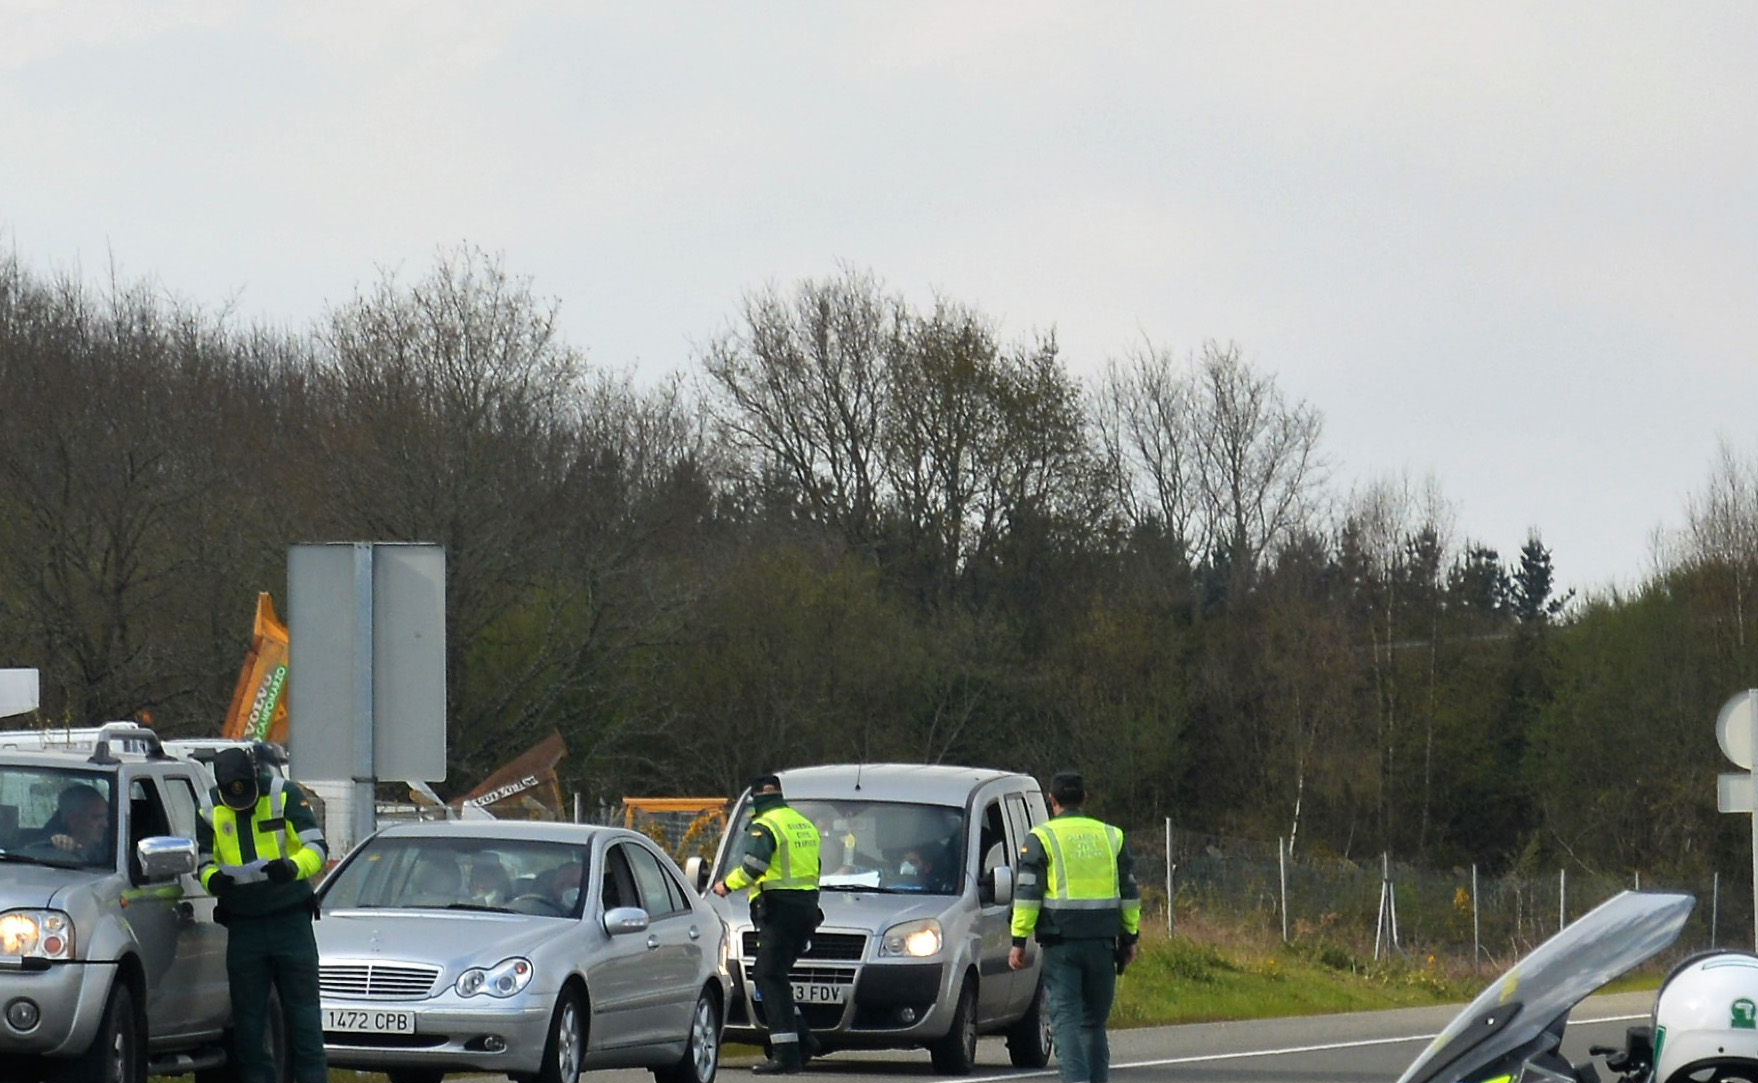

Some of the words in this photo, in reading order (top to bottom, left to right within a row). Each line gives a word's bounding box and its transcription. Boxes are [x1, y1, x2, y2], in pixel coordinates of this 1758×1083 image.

[244, 673, 272, 737] VOLVO
[810, 986, 840, 1001] FDV
[330, 1011, 368, 1029] 1472
[375, 1013, 407, 1030] CPB
